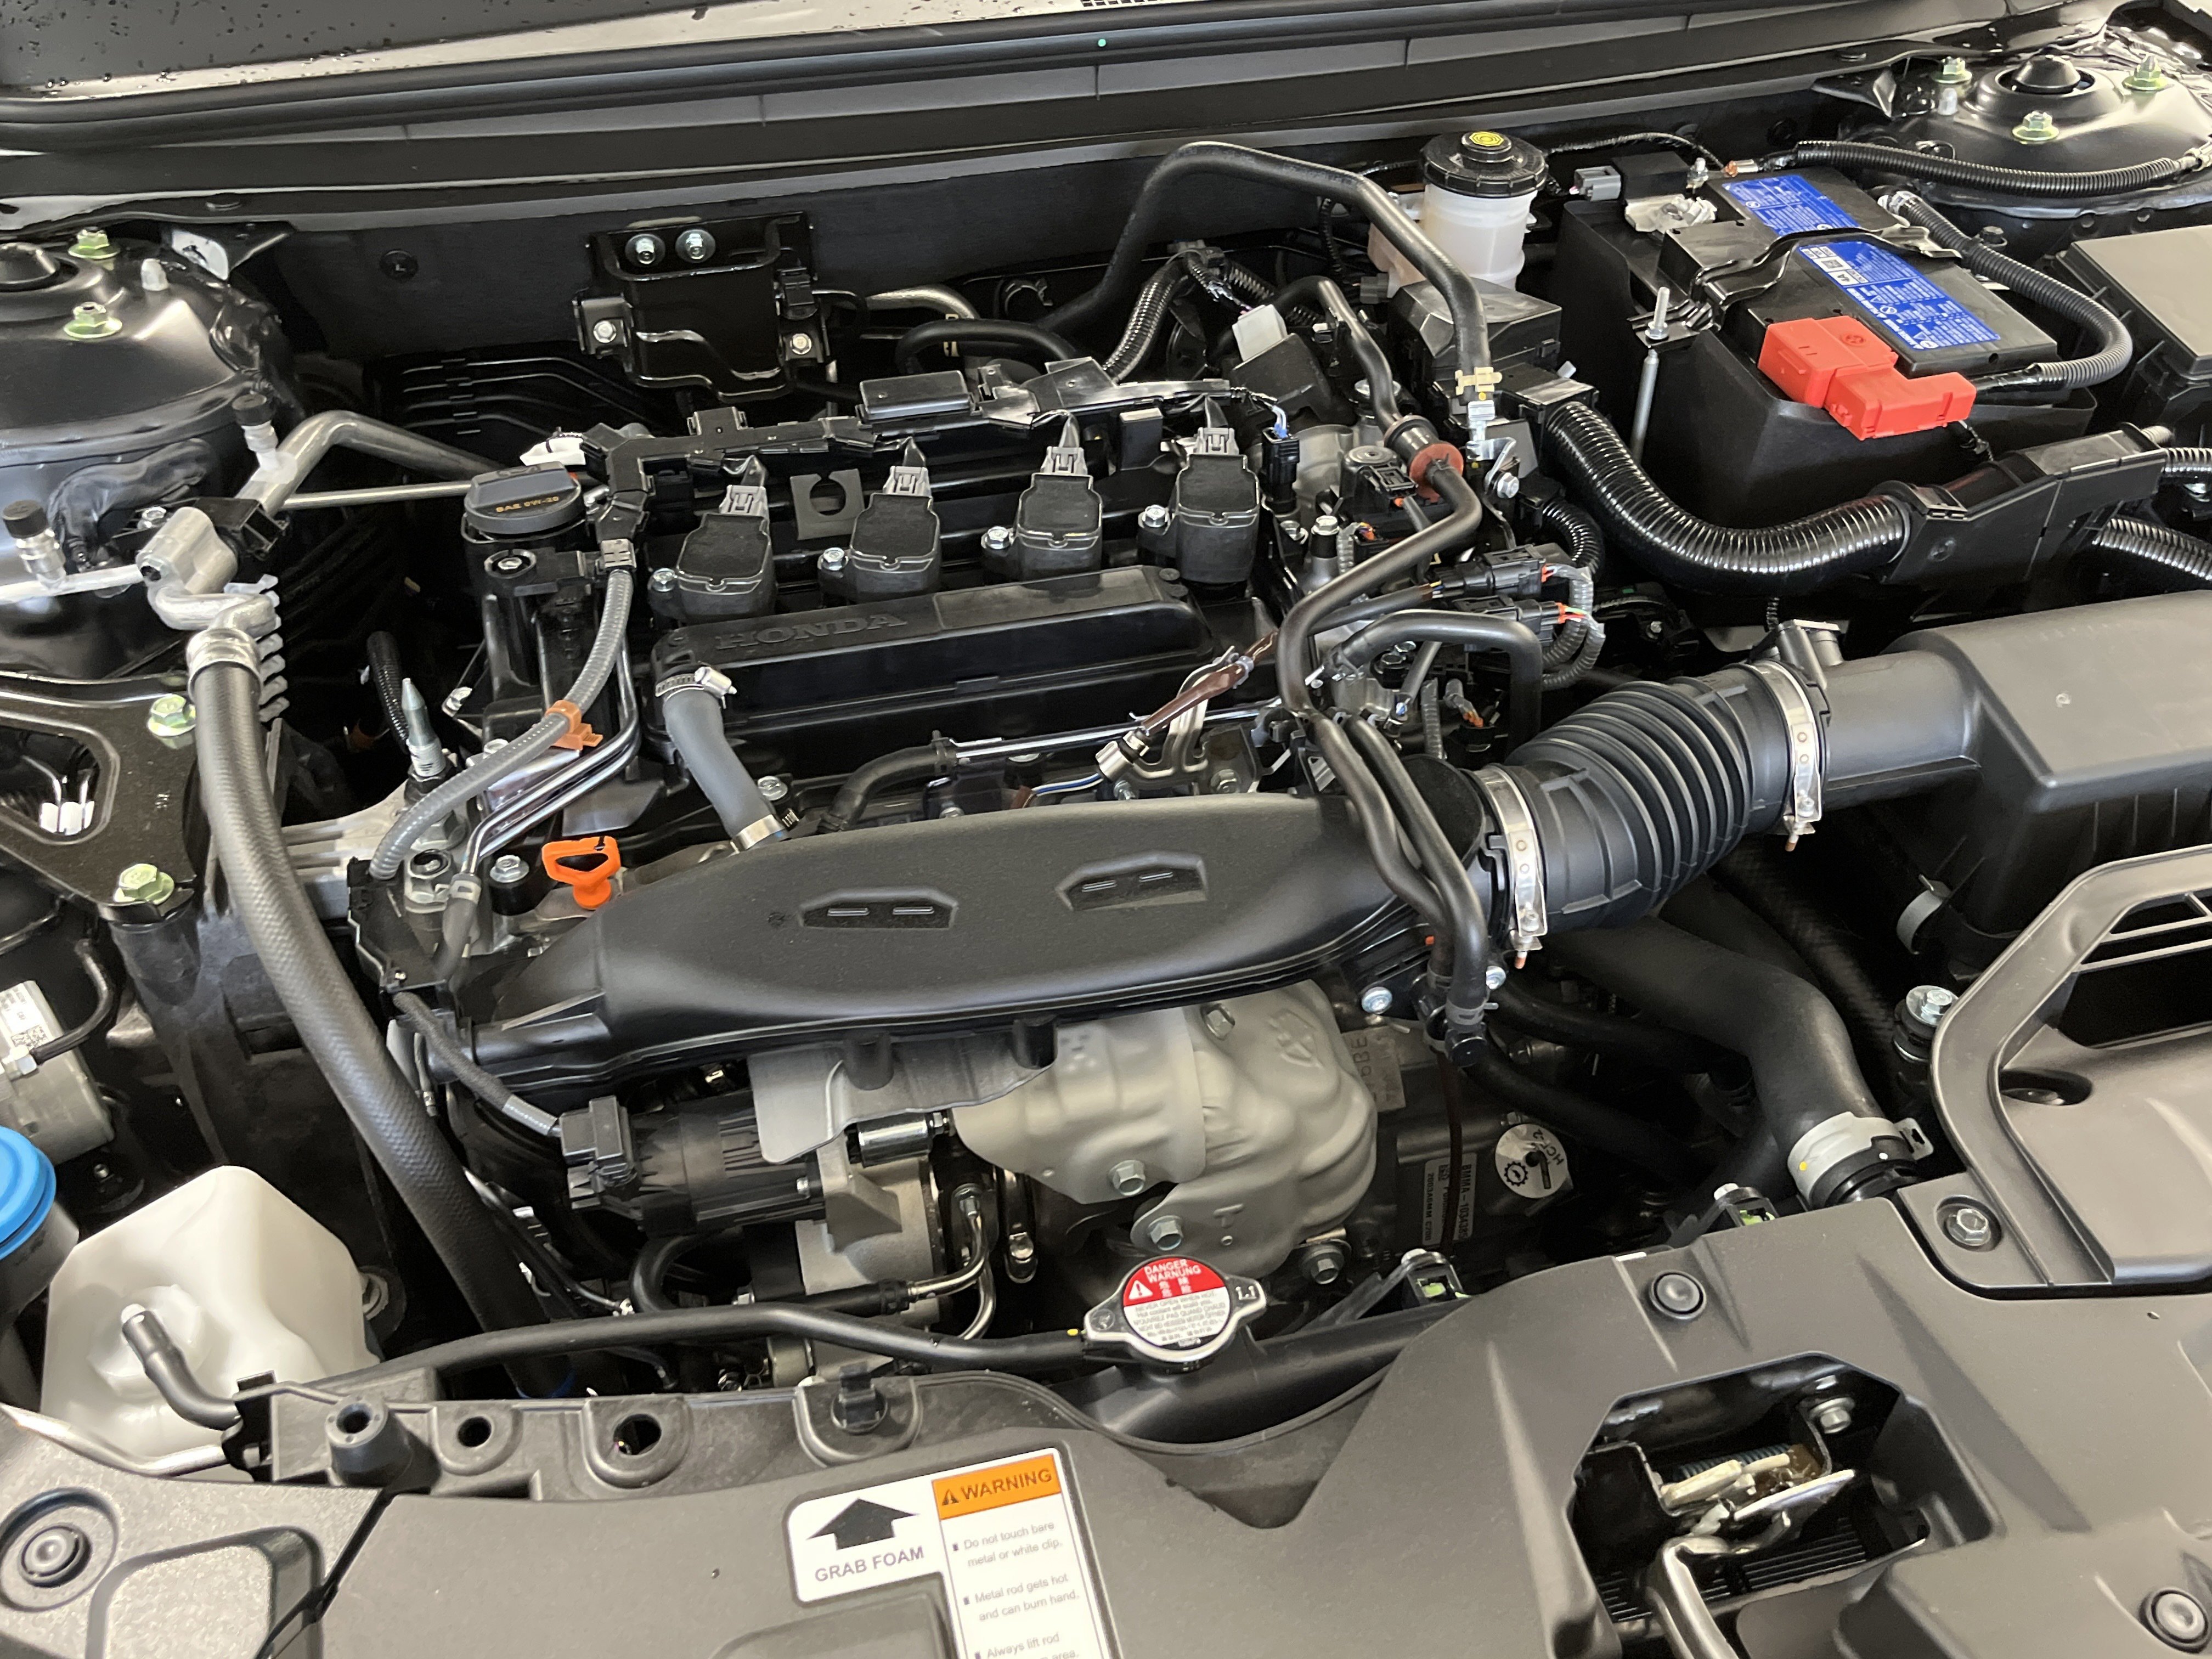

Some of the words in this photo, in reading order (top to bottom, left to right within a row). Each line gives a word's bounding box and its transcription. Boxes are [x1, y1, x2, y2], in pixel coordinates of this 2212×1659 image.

[496, 504, 522, 512] SAE
[524, 496, 559, 507] 0W-20
[715, 613, 907, 650] HONDA
[1144, 1259, 1188, 1274] DANGER
[1147, 1265, 1201, 1284] WARNUNG
[960, 1468, 1053, 1500] WARNING
[963, 1539, 979, 1549] Do
[982, 1533, 998, 1545] not
[1000, 1527, 1029, 1541] touch
[1031, 1522, 1054, 1534] bare
[815, 1558, 867, 1583] GRAB
[871, 1545, 926, 1570] FOAM
[968, 1551, 996, 1567] metal
[998, 1551, 1009, 1559] or
[1012, 1544, 1039, 1556] white
[1042, 1539, 1063, 1549] clip.
[975, 1587, 1004, 1603] Metal
[1007, 1583, 1024, 1595] rod
[1026, 1578, 1049, 1592] gets
[1051, 1572, 1069, 1585] hot
[979, 1607, 999, 1621] and
[1001, 1605, 1021, 1616] can
[1023, 1598, 1047, 1611] burn
[1049, 1589, 1080, 1605] hand.
[988, 1643, 1025, 1658] Always
[1026, 1637, 1040, 1649] lift
[1042, 1632, 1060, 1645] rod
